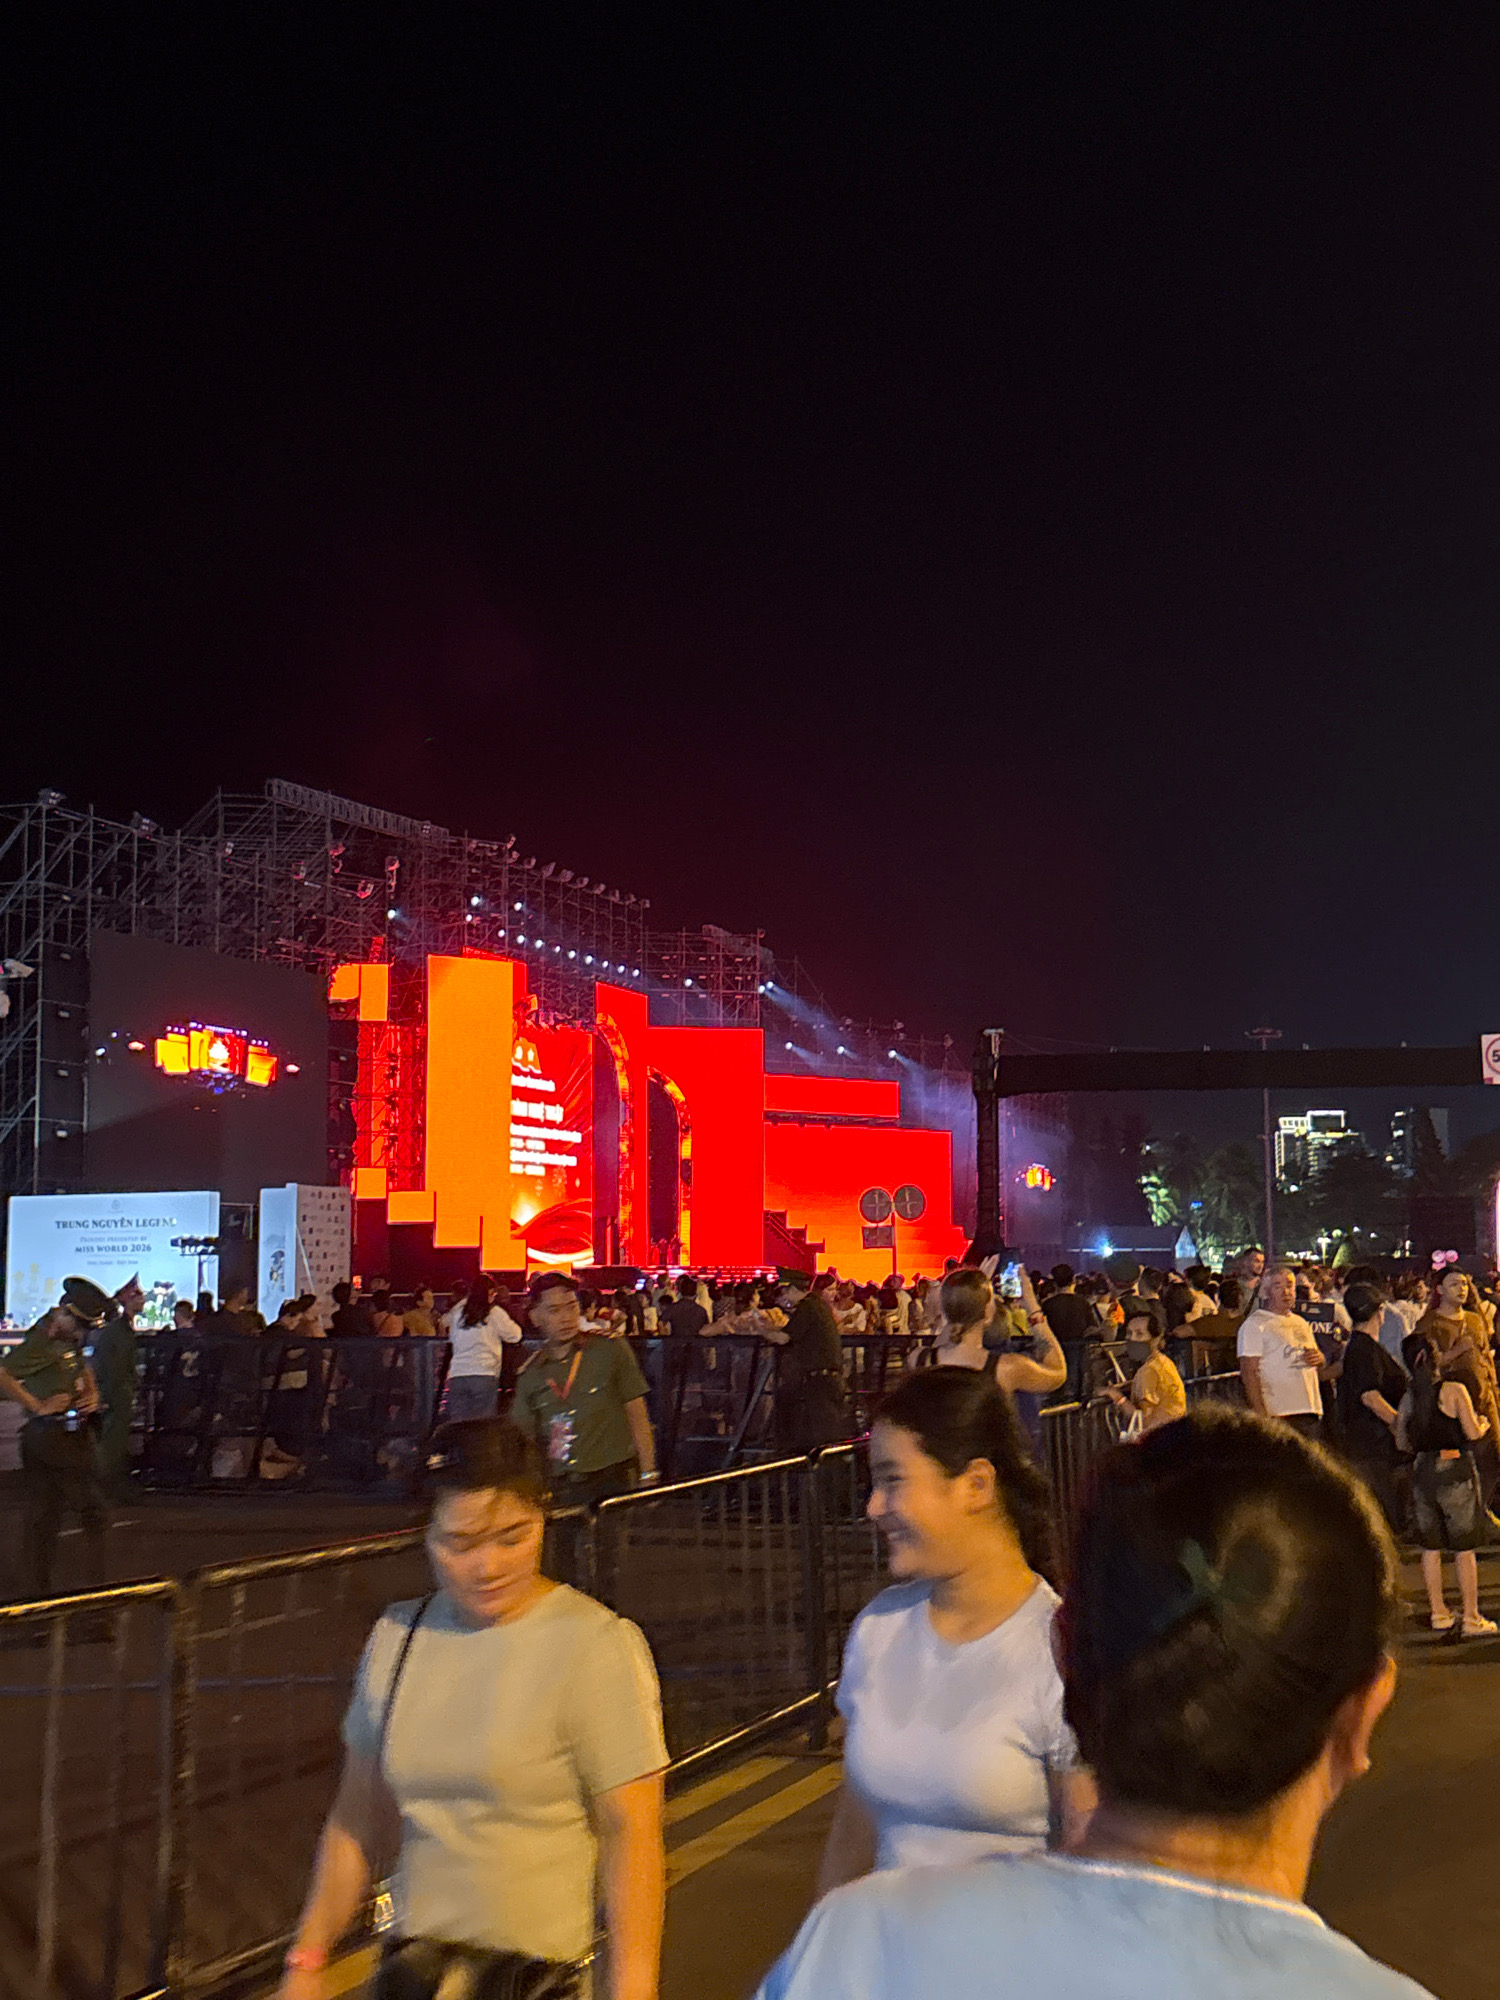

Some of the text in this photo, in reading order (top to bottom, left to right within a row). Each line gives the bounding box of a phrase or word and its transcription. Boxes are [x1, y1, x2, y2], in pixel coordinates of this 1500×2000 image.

[55, 1220, 89, 1229] TRUNG
[92, 1217, 133, 1228] NGUYÊN
[75, 1243, 152, 1253] MISS WORLD 2026
